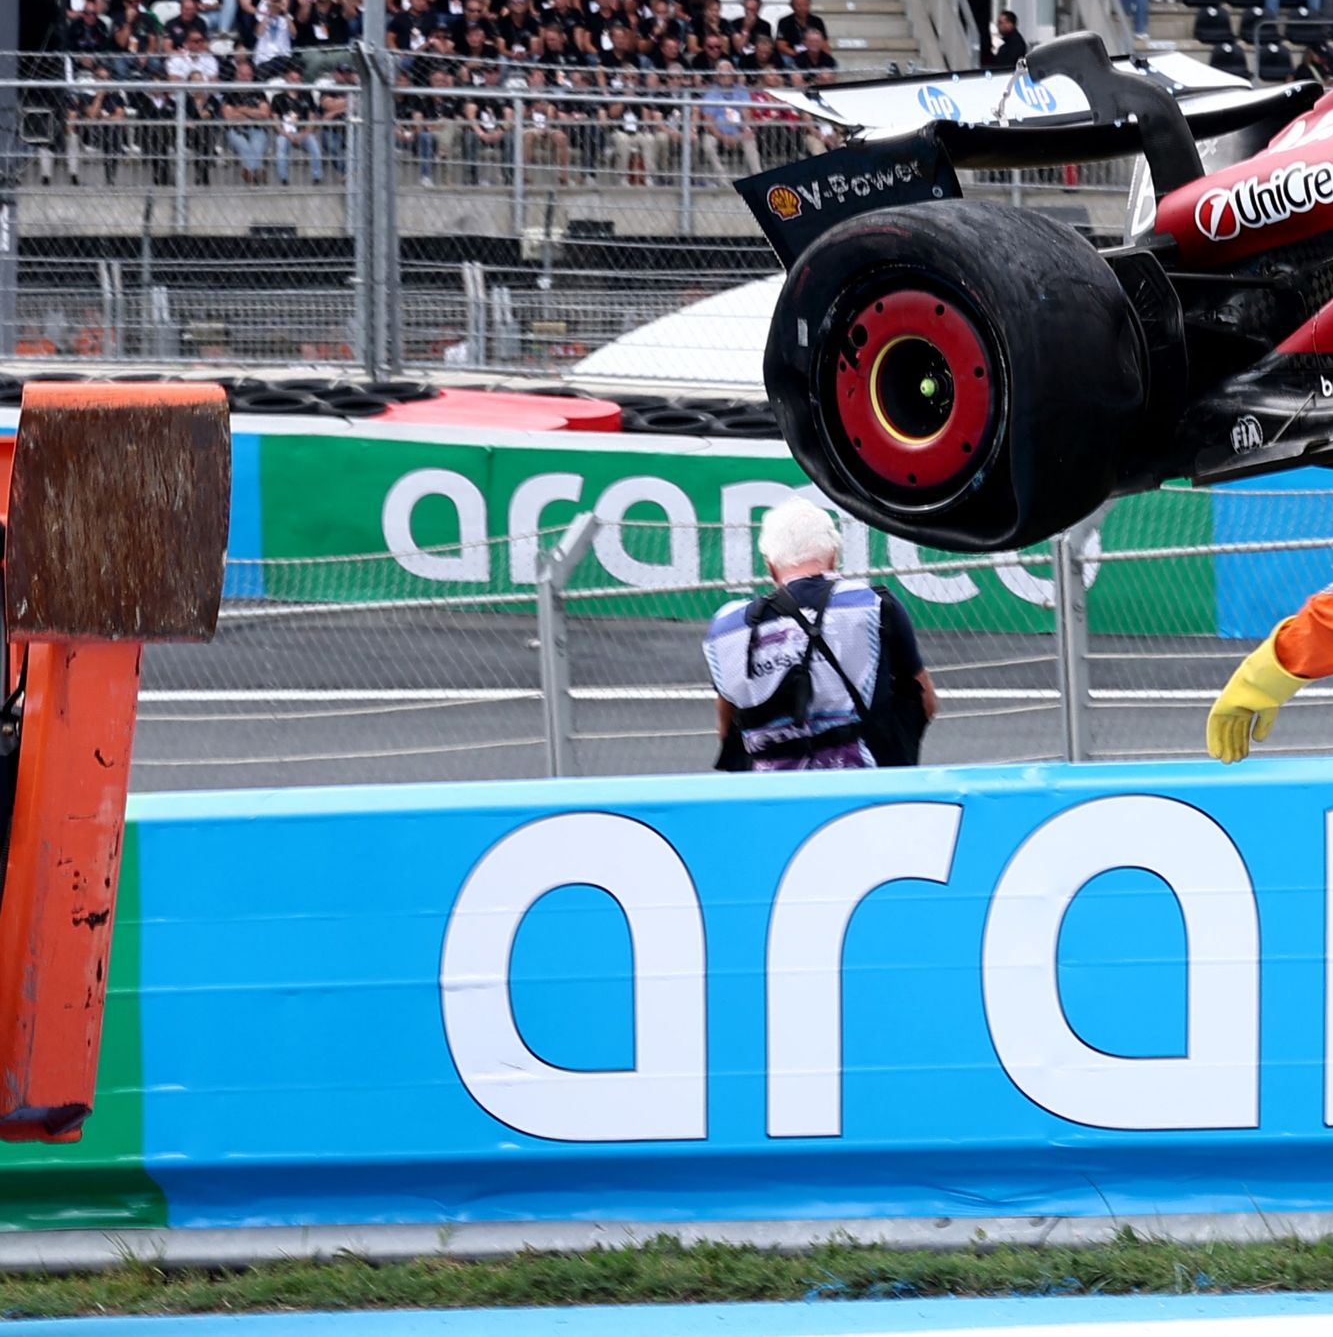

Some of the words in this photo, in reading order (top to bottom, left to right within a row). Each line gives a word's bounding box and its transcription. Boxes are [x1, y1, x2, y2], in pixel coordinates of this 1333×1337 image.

[922, 86, 958, 120] hp
[1018, 74, 1054, 112] hp
[799, 160, 921, 211] V-Power
[1232, 419, 1263, 451] FIA
